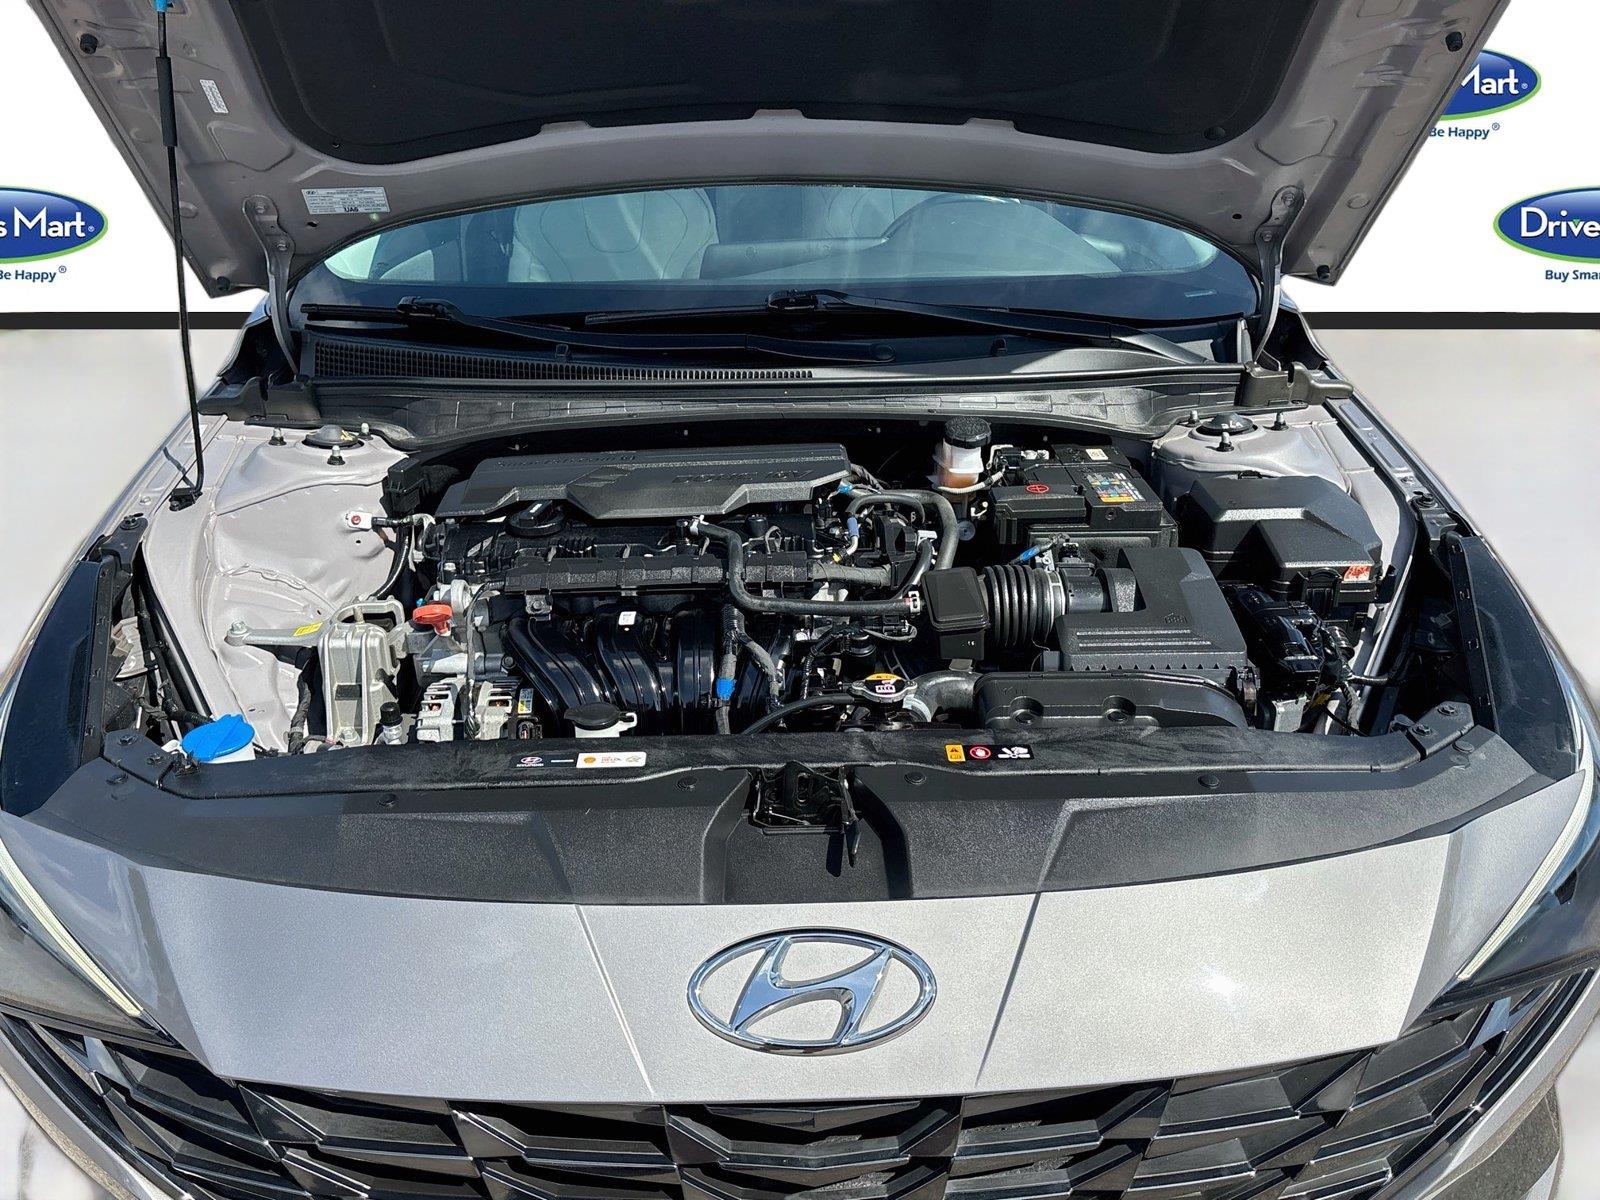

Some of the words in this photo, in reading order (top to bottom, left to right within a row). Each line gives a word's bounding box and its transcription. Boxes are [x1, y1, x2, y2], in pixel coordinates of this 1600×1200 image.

[1448, 127, 1490, 139] Happy
[13, 206, 86, 238] Mart
[15, 270, 57, 282] Happy
[1545, 269, 1569, 282] Buy
[1572, 269, 1600, 280] Sma
